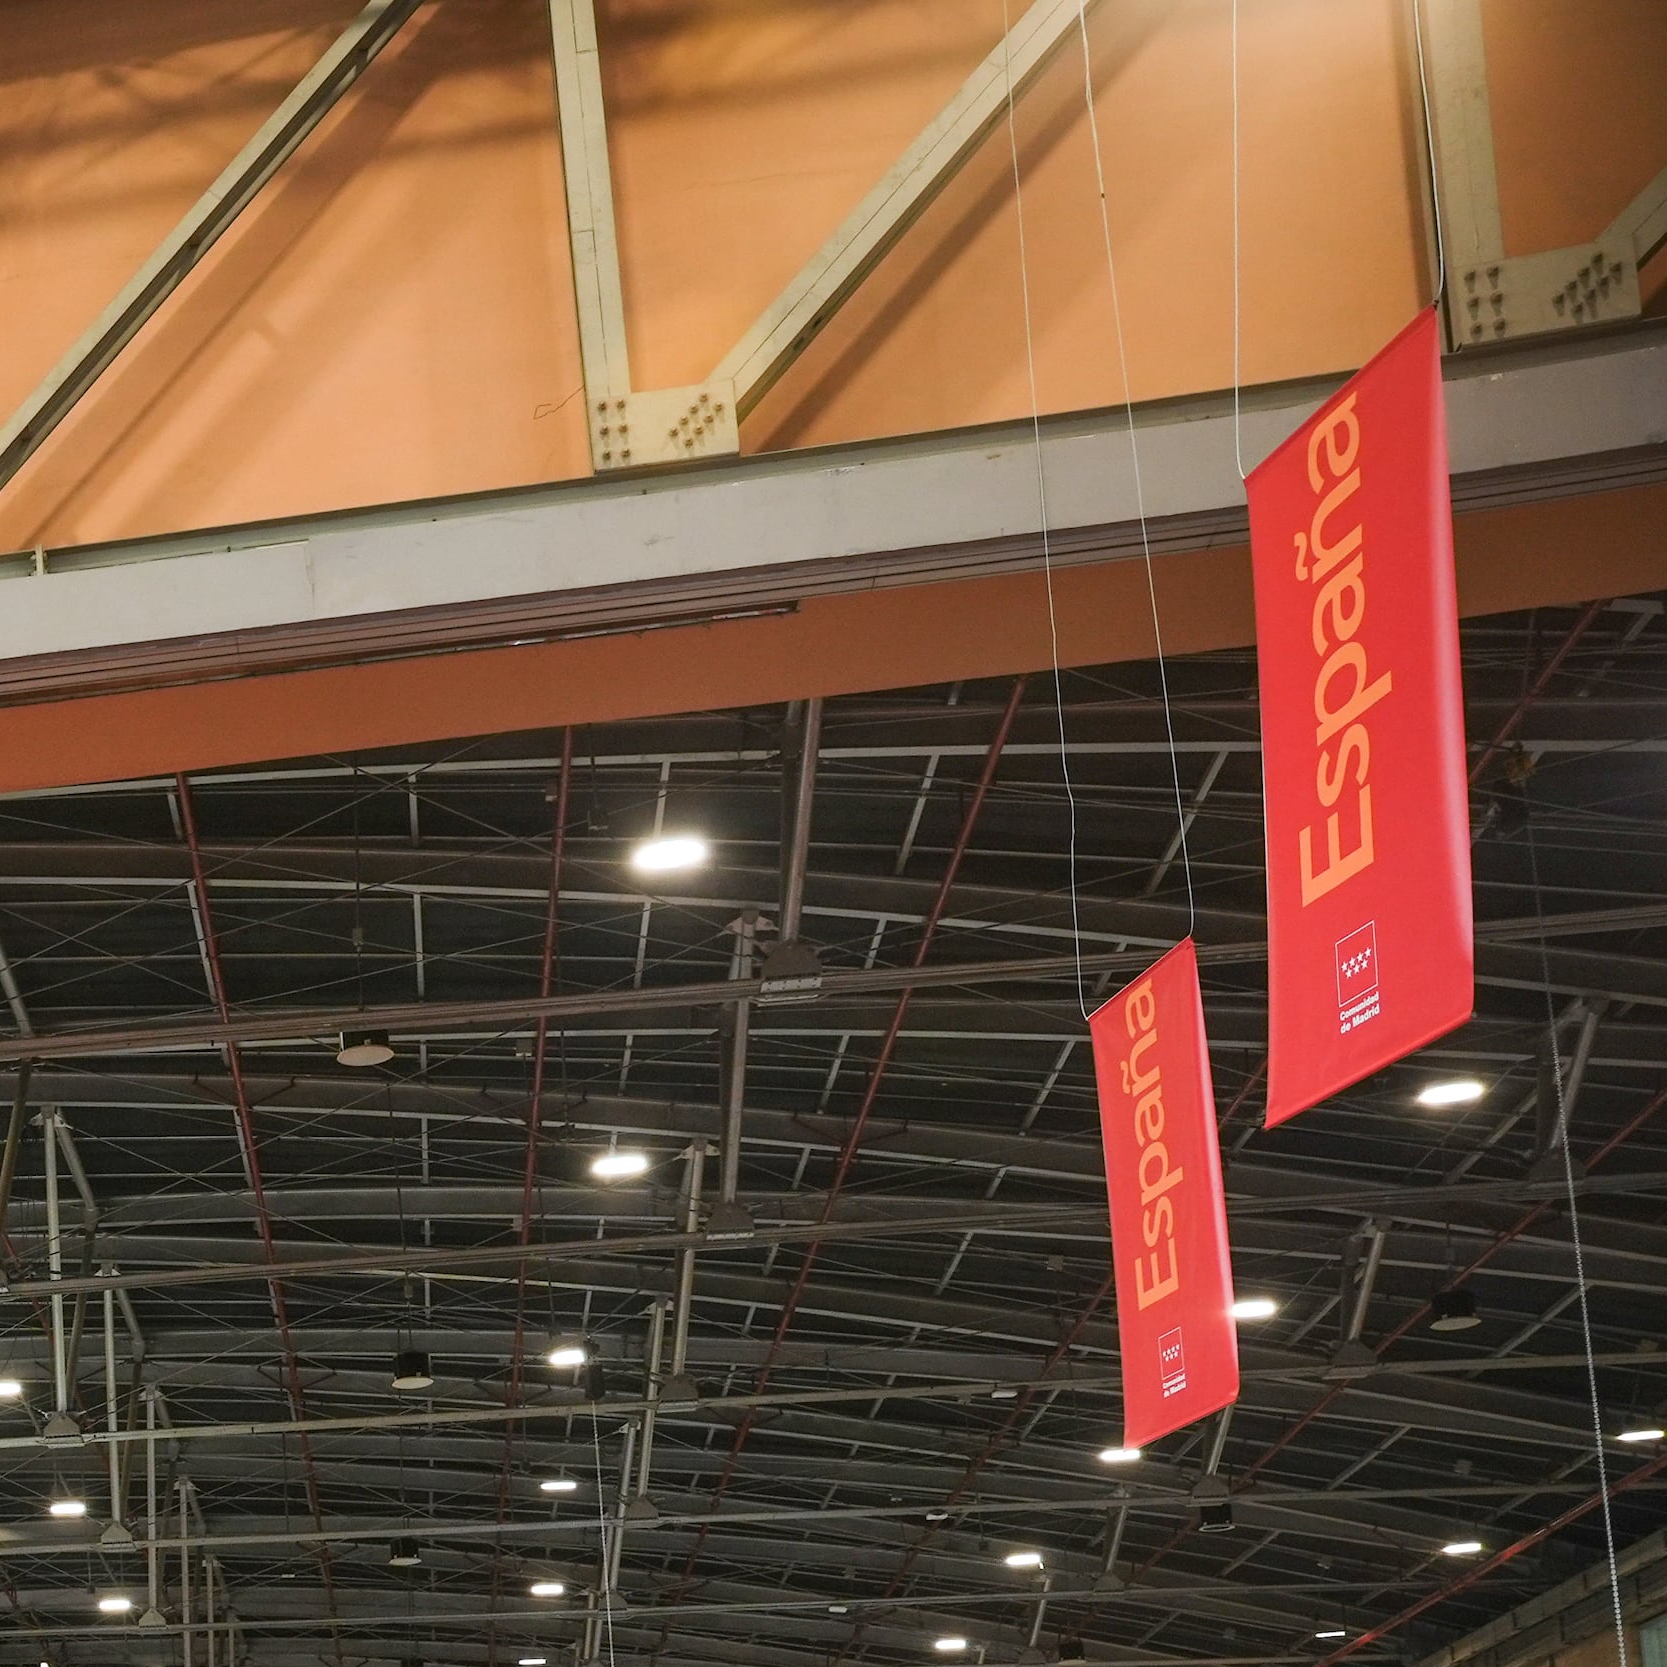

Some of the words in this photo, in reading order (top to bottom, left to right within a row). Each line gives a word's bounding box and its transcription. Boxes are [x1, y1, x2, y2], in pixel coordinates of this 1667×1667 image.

[1295, 390, 1393, 910] España
[1340, 991, 1379, 1021] Comunidad
[1340, 1022, 1351, 1034] de
[1352, 1003, 1380, 1027] Madrid
[1120, 978, 1183, 1311] España
